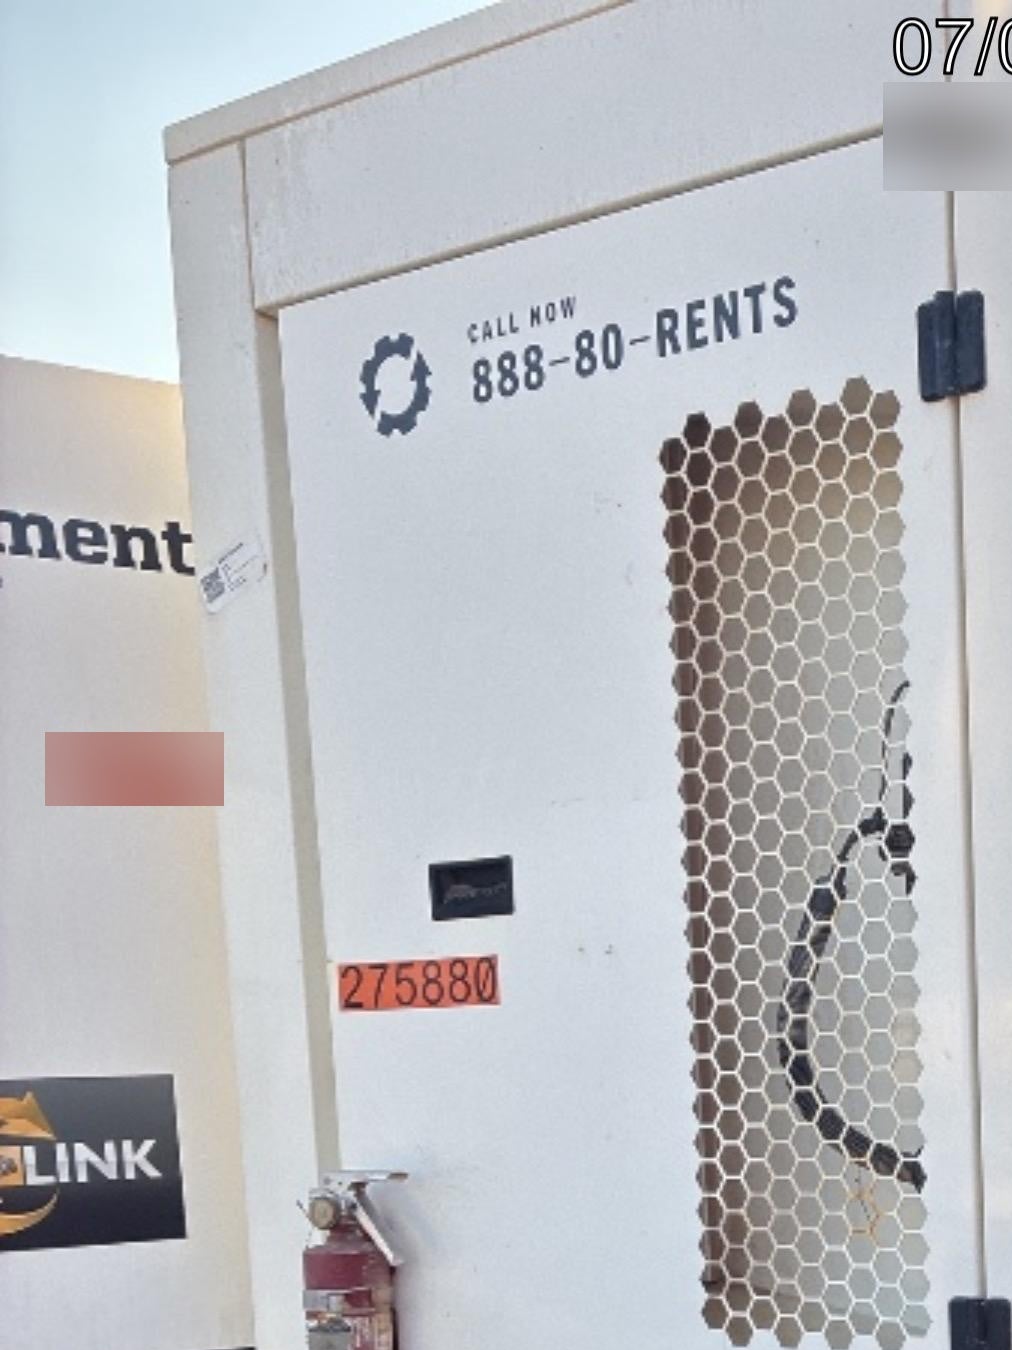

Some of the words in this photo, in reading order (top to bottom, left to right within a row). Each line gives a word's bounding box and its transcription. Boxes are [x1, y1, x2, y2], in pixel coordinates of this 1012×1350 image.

[466, 312, 520, 344] CALL
[529, 296, 577, 329] NOW
[472, 275, 799, 404] 888-80-RENTS
[341, 956, 499, 1009] 275880
[23, 1138, 163, 1187] LINK
